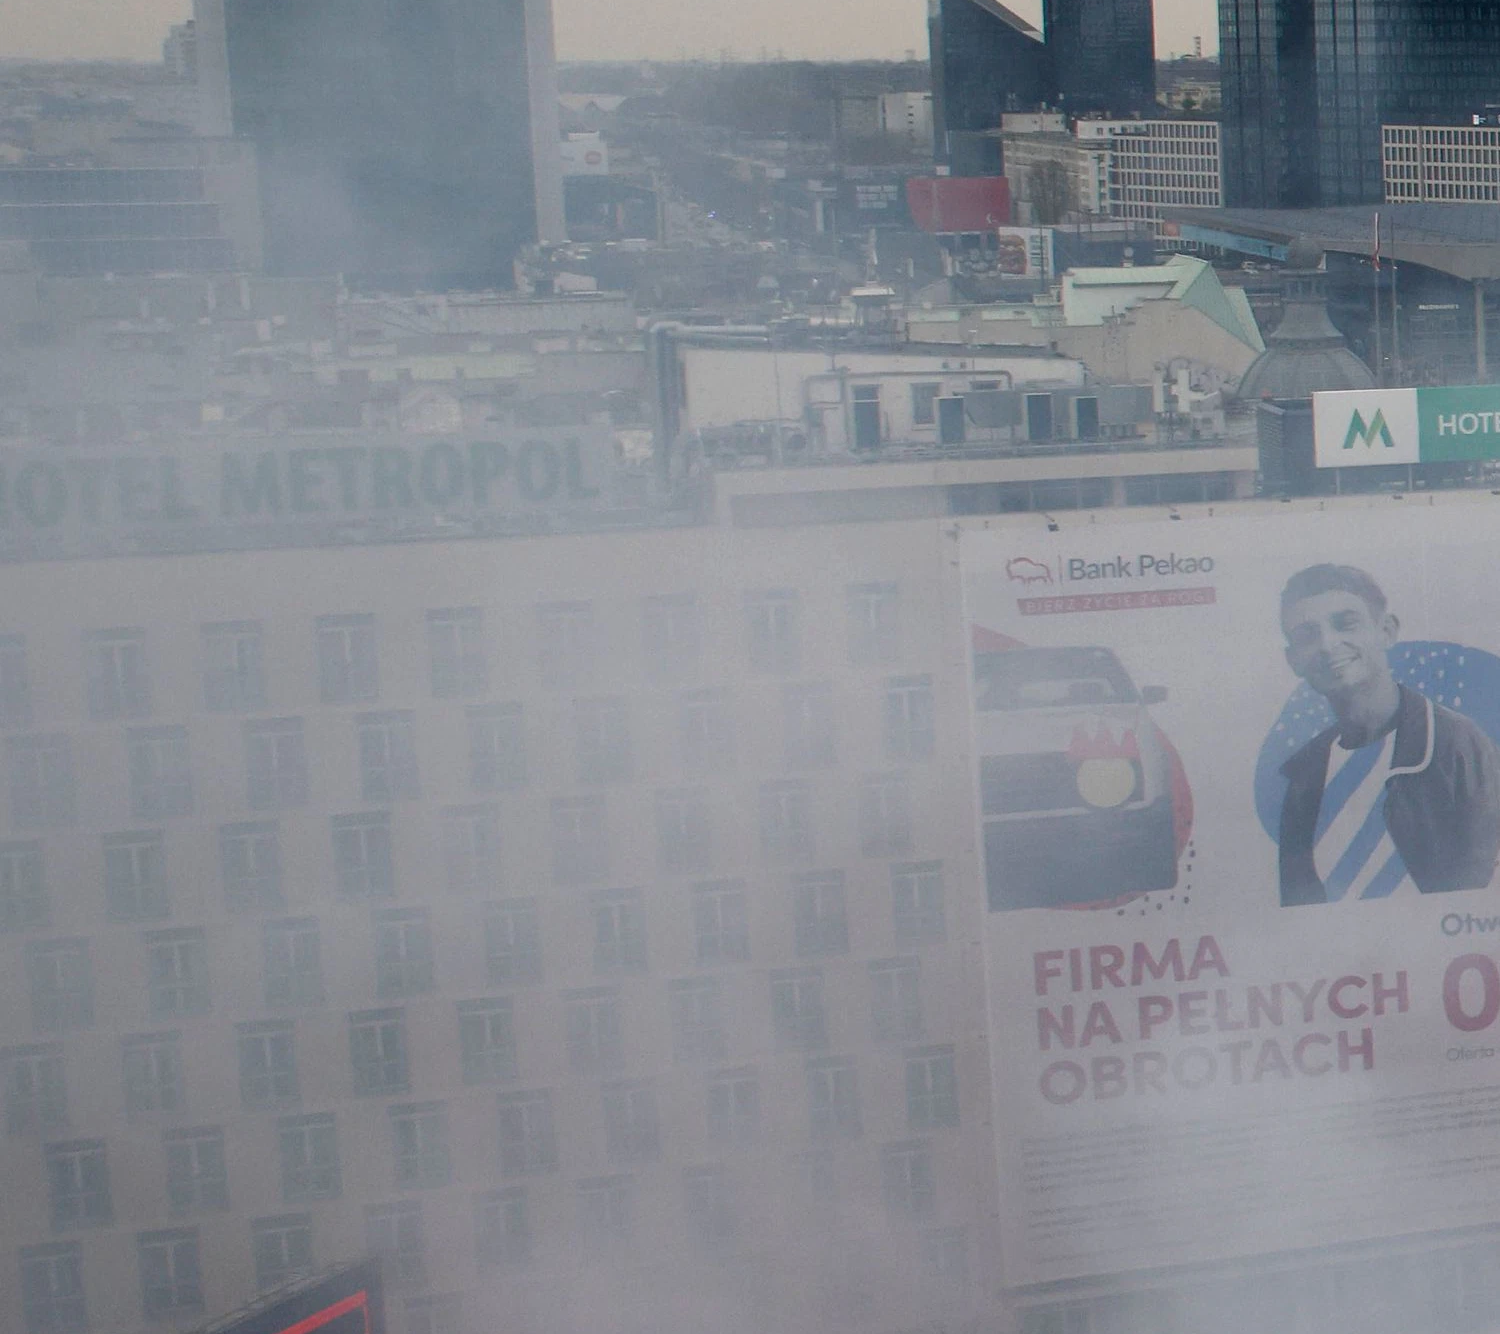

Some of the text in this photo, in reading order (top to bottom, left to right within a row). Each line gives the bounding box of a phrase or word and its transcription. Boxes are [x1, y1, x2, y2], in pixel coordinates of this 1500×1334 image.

[219, 434, 600, 517] METROPOL
[1067, 553, 1215, 581] Bank Pekao
[1034, 934, 1231, 996] FIRMA
[1443, 953, 1500, 1032] 0
[1036, 1000, 1123, 1051] NA
[1446, 1043, 1496, 1063] Oferta
[1039, 1024, 1376, 1105] OBROTACH
